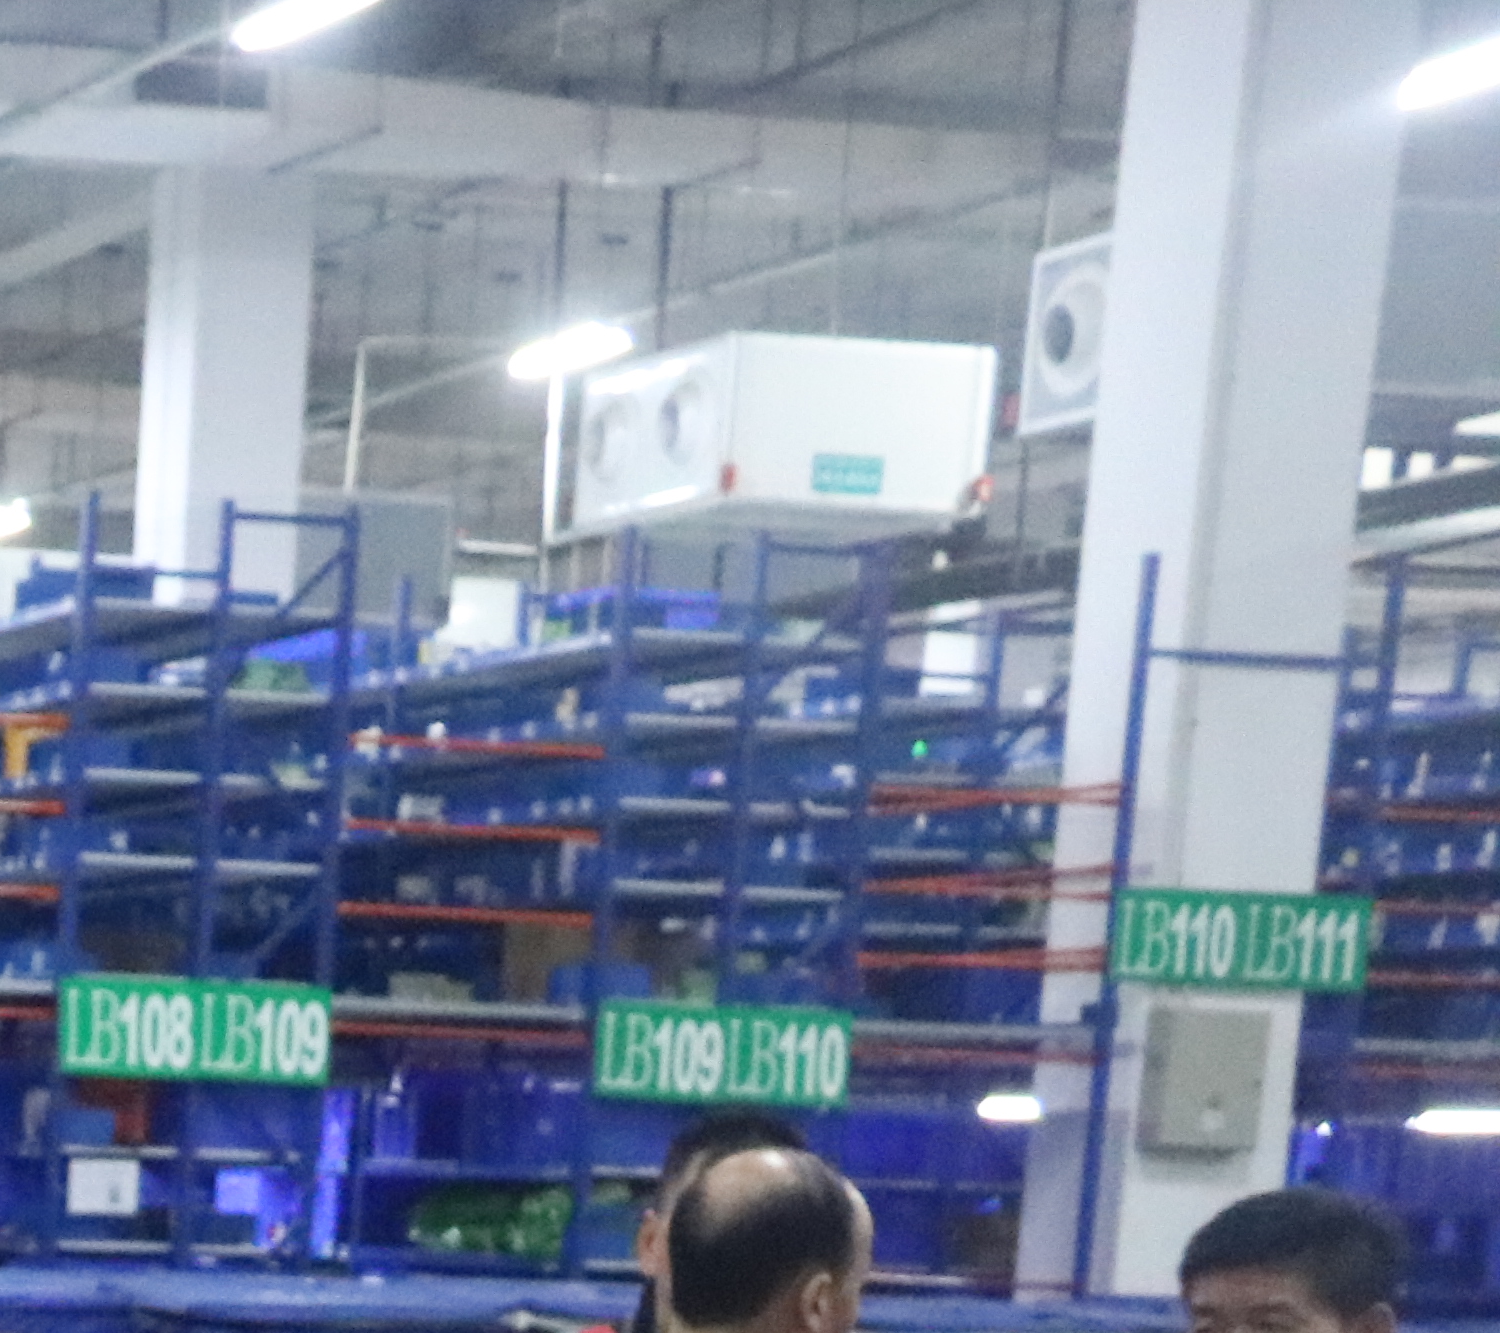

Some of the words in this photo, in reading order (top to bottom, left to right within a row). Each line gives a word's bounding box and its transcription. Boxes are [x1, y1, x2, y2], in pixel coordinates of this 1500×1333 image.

[1118, 898, 1237, 979] LB110
[1242, 902, 1360, 984] LB111
[65, 987, 193, 1069] LB108
[201, 991, 329, 1077] LB109
[601, 1010, 725, 1095] LB109
[726, 1017, 848, 1099] LB110
